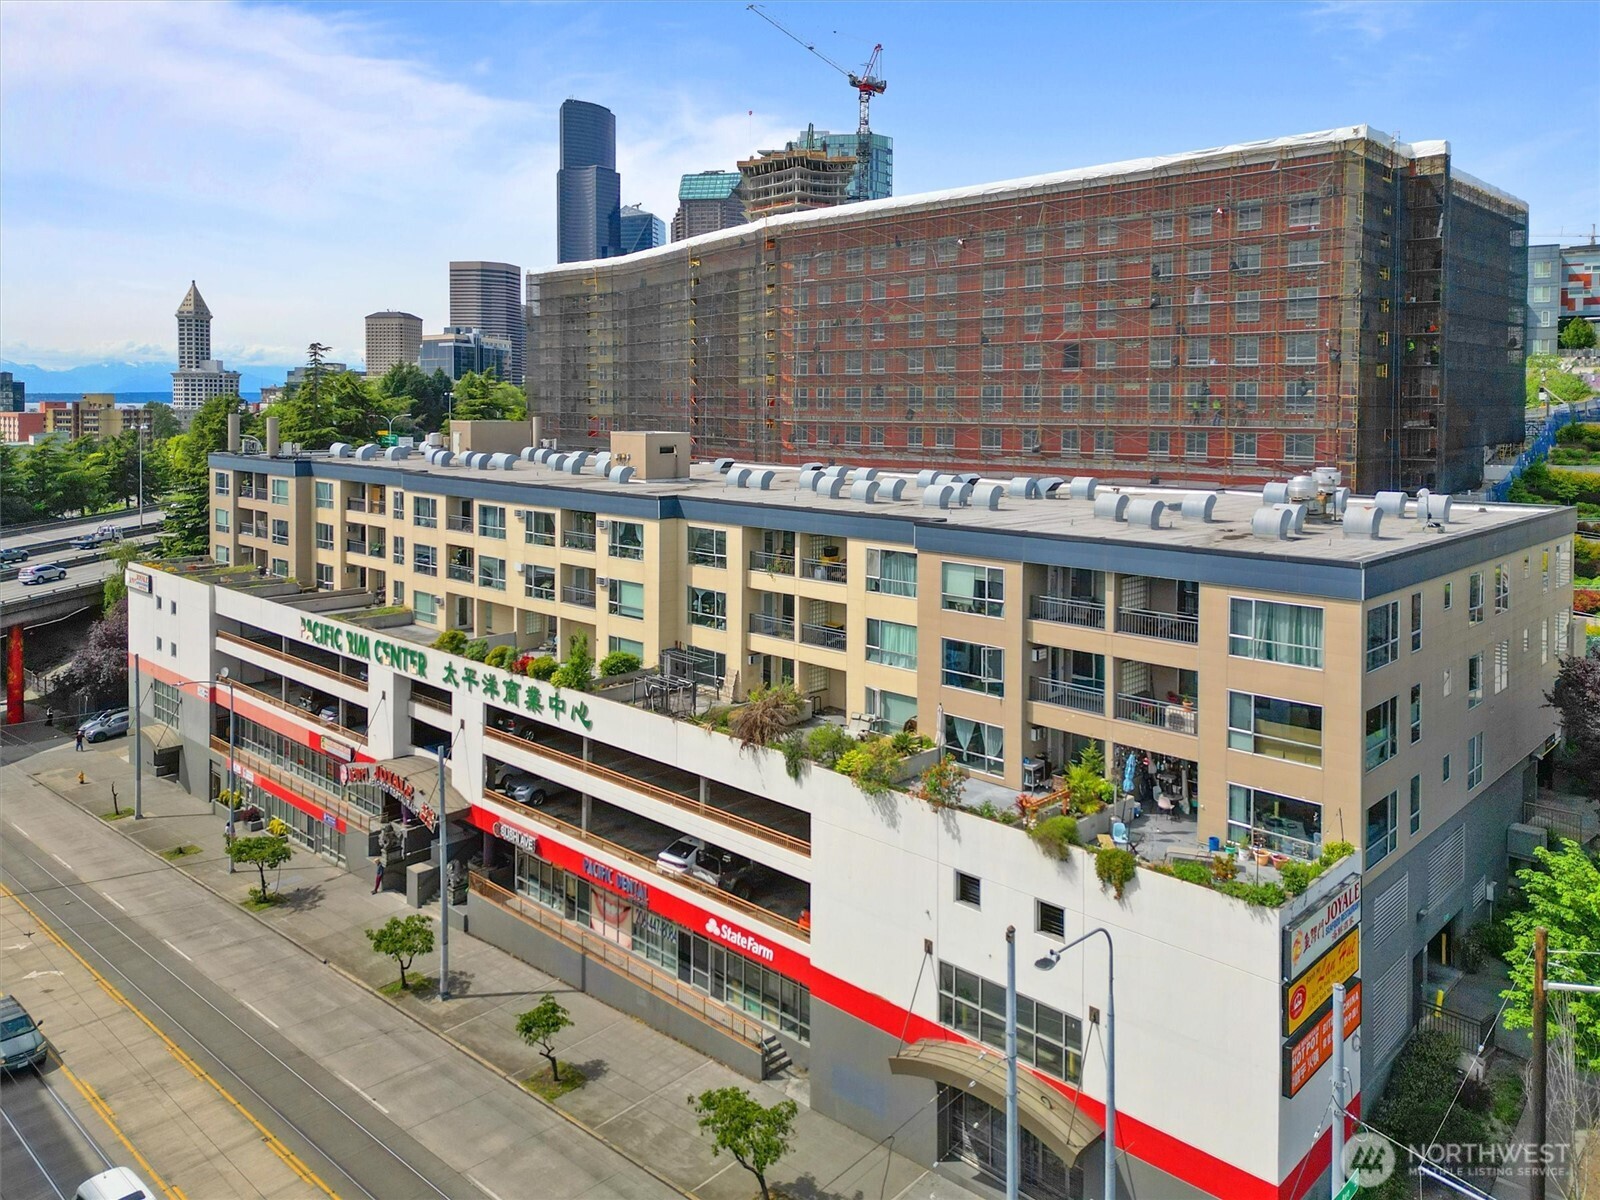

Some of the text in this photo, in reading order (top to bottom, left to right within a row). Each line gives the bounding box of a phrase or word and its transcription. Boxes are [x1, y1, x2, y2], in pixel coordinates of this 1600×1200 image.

[300, 616, 343, 652] PACIFIC
[373, 639, 427, 679] CENTER
[442, 661, 593, 732] 太平洋商業中心
[583, 857, 649, 901] PACIFIC DENTAL
[1324, 882, 1360, 926] JOYALE
[1343, 990, 1360, 1013] CHINA
[1292, 1046, 1305, 1072] HOT
[1306, 1032, 1319, 1056] POT
